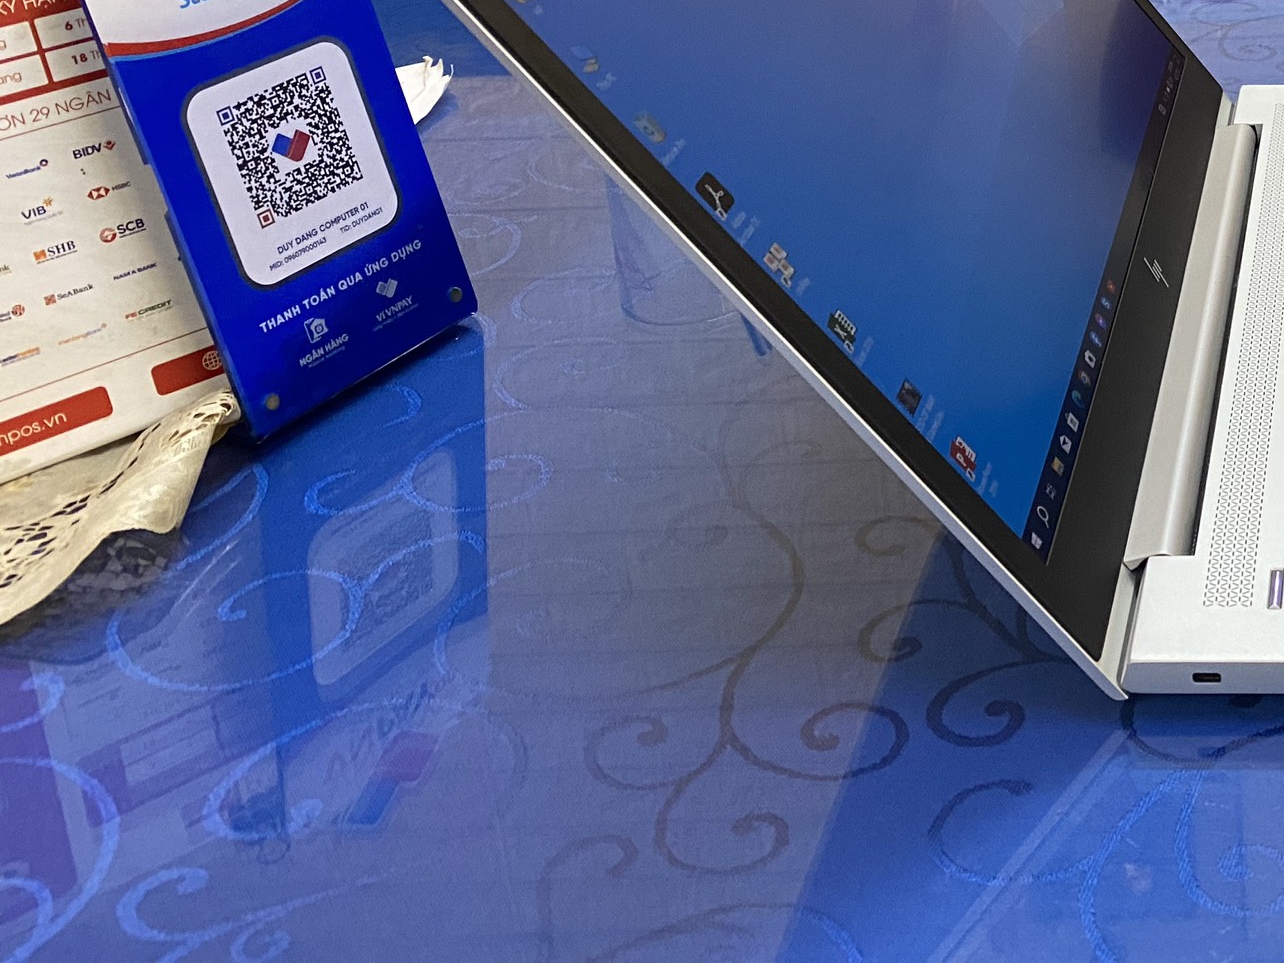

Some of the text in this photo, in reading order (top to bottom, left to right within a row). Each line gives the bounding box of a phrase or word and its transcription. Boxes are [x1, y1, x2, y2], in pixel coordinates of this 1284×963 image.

[65, 21, 74, 31] 6
[72, 53, 88, 65] 18
[30, 106, 50, 123] 29
[55, 89, 112, 116] NGÂN
[72, 142, 102, 160] BIDV
[21, 205, 47, 220] VIB
[116, 218, 145, 235] SCB
[277, 201, 370, 255] DUY DANG COMPUTER 01
[47, 240, 76, 257] SHB
[56, 283, 94, 300] SeABank
[259, 240, 423, 333] THANH TOÁN QUA ỨNG DỤNG
[138, 299, 172, 316] CREDIT
[386, 295, 414, 316] VNPAY
[299, 346, 326, 368] NGÂN
